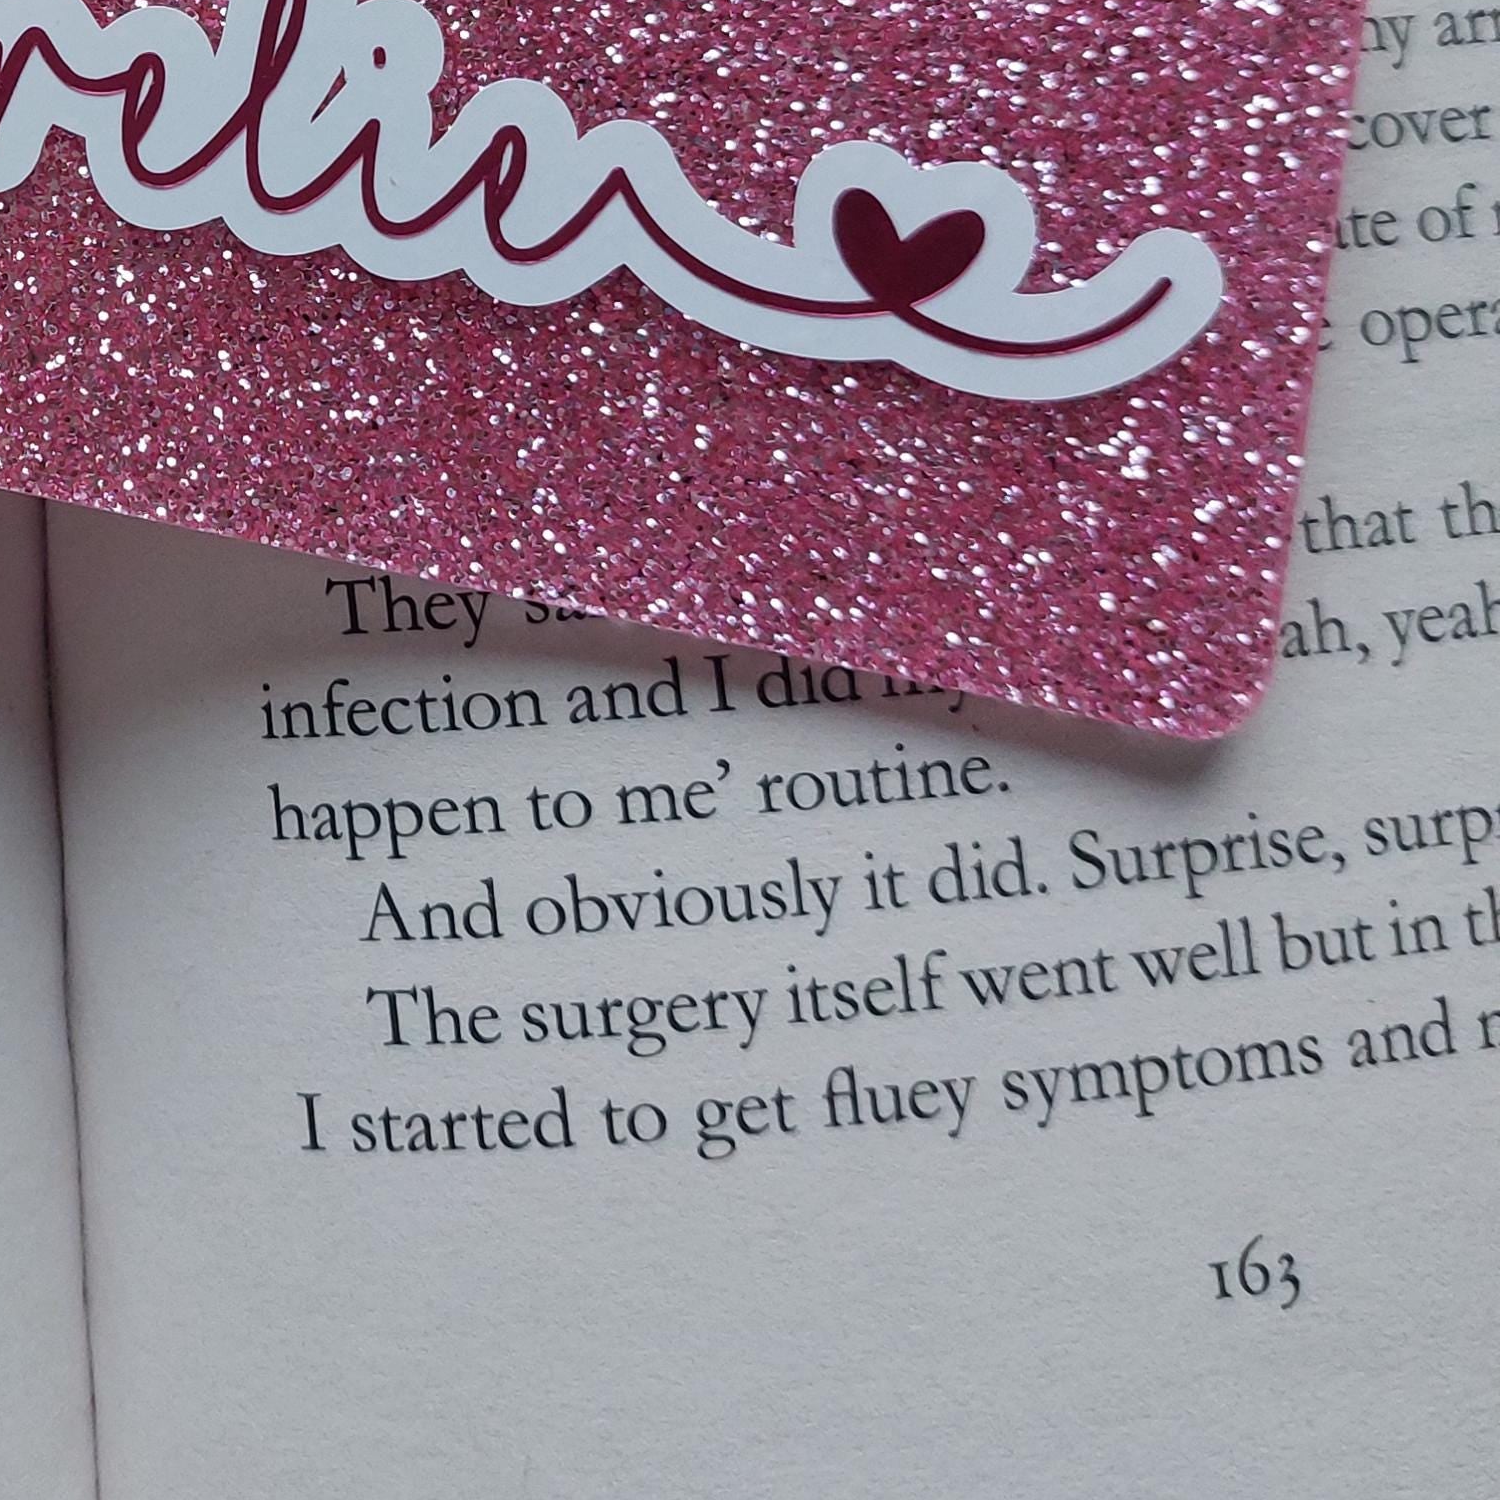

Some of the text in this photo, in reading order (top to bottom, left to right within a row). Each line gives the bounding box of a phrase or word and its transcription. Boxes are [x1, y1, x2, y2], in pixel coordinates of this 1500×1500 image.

[266, 742, 1012, 862] happen to me’ routine.
[358, 811, 1347, 943] And obviously it did. Surprise,
[365, 898, 1452, 1059] The surgery itself went well but in
[296, 994, 1459, 1162] I started to get fluey symptoms and
[1207, 1233, 1302, 1311] 163
